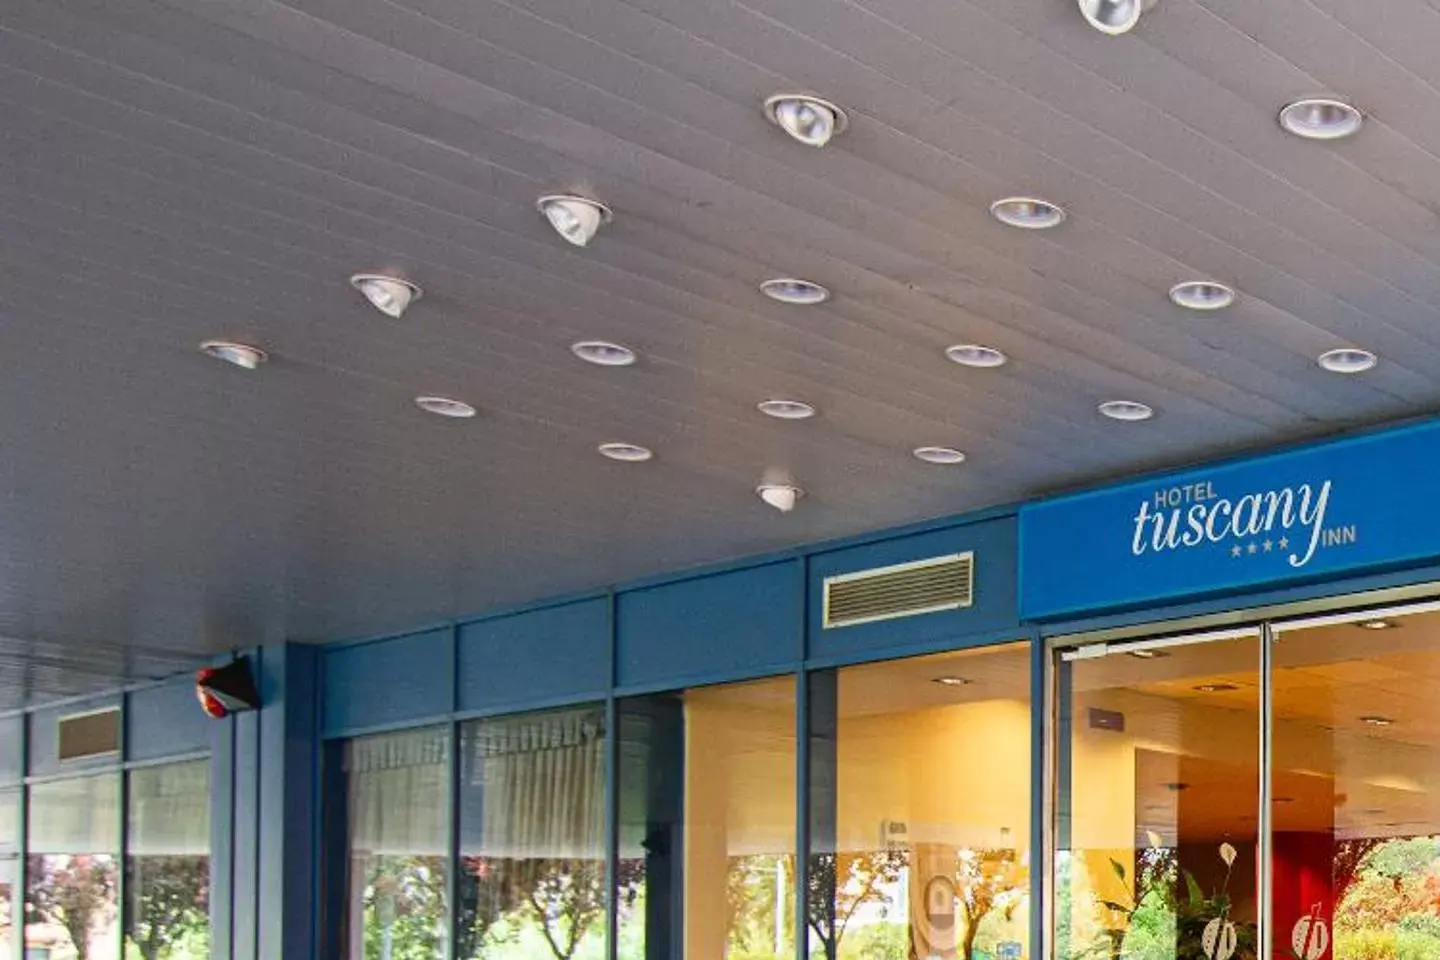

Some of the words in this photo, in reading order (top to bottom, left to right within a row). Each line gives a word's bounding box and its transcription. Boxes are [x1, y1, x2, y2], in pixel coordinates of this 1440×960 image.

[1155, 481, 1217, 508] HOTEL
[1132, 480, 1332, 567] tuscany
[1321, 525, 1357, 548] INN
